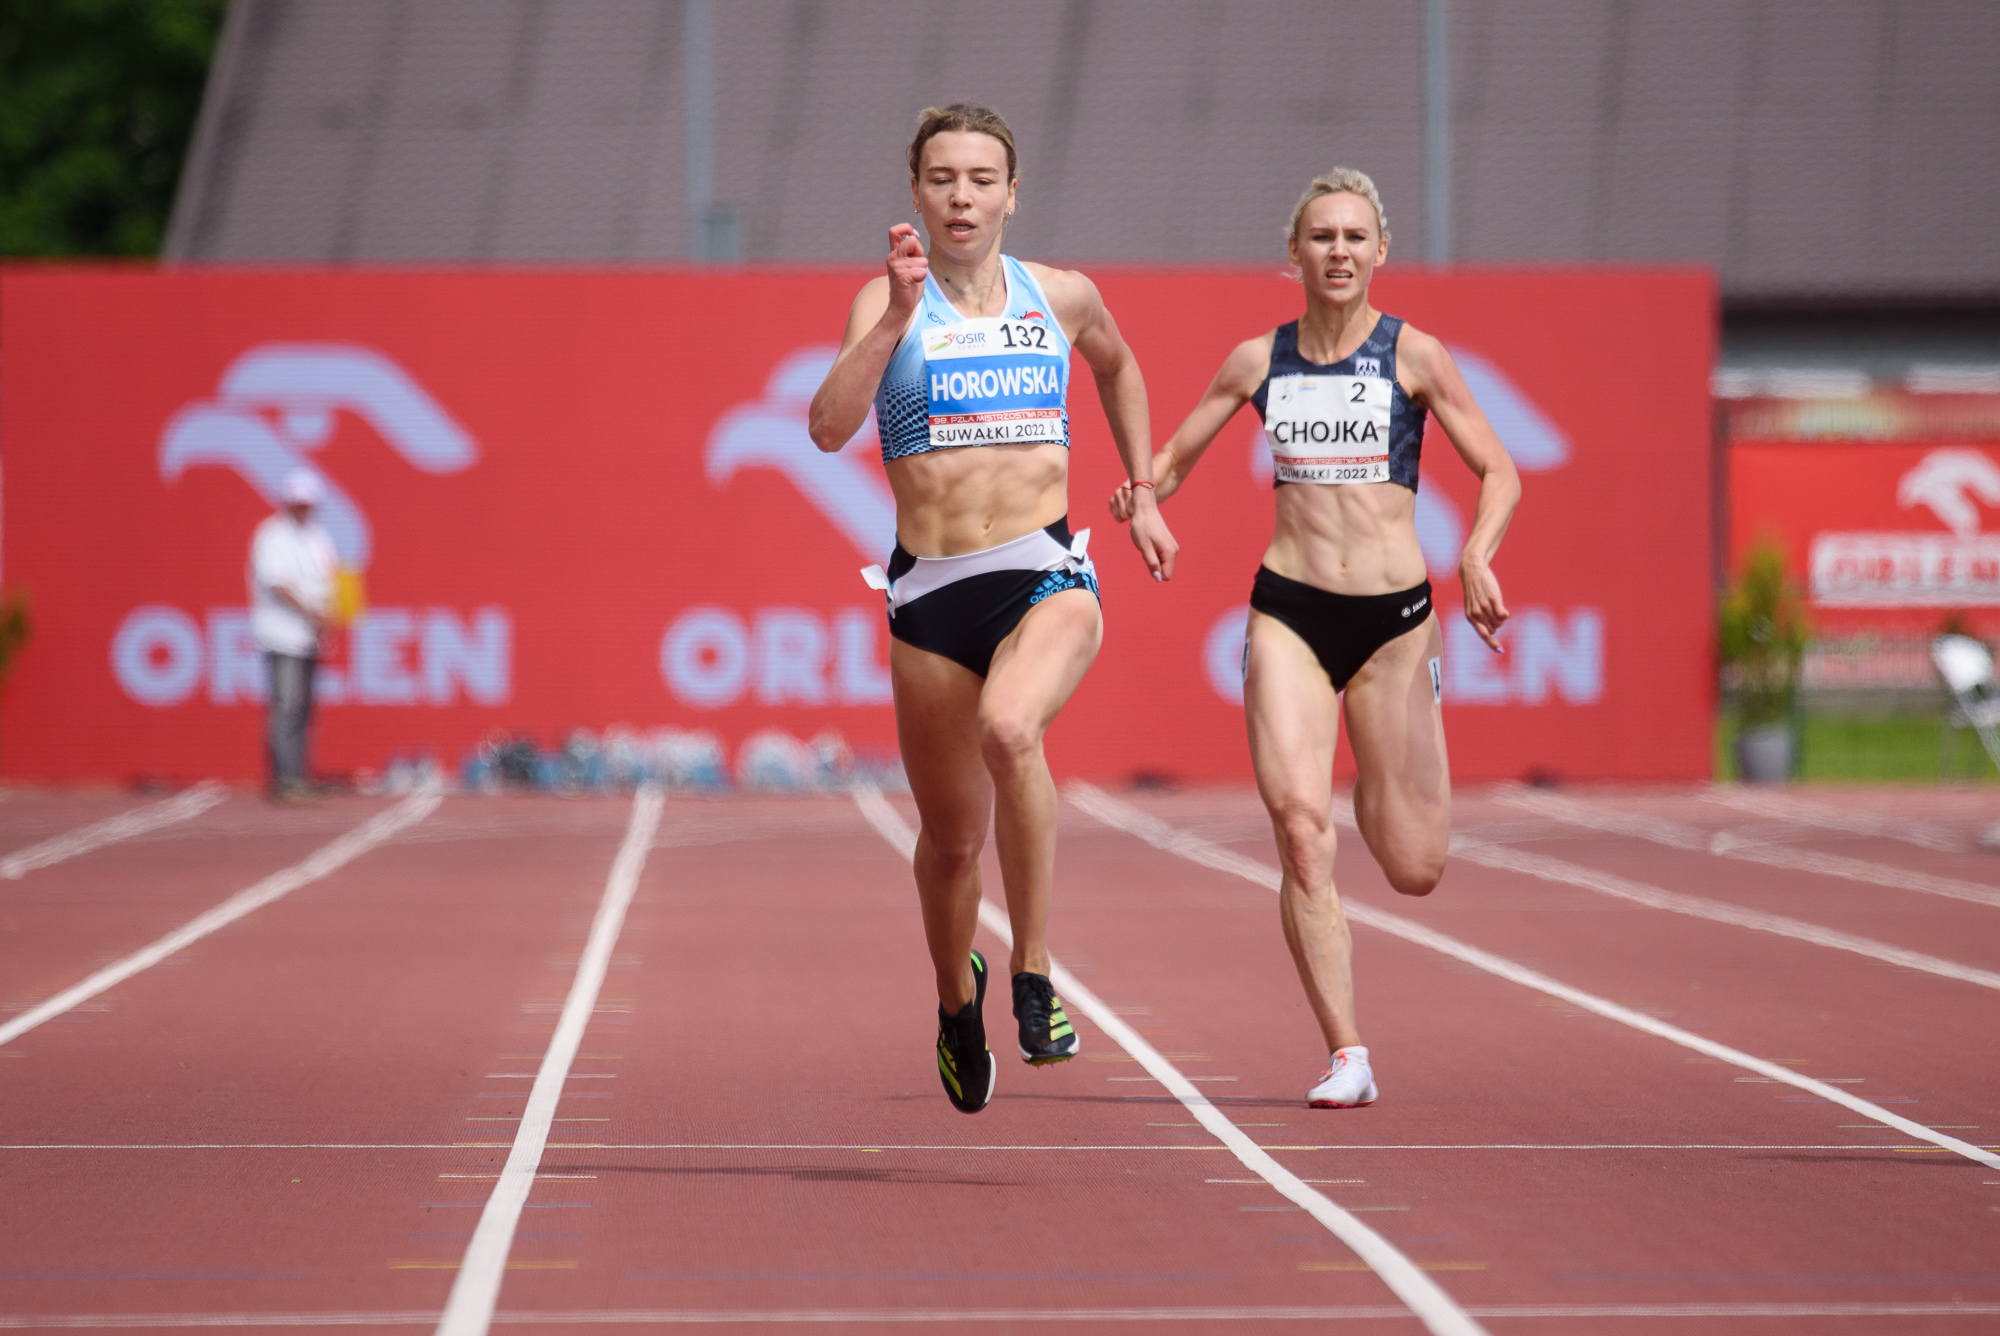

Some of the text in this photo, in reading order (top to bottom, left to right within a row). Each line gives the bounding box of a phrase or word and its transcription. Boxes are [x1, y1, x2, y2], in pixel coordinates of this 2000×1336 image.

[956, 332, 986, 345] OSIR
[999, 323, 1049, 350] 132
[932, 366, 1059, 401] HOROWSKA
[1350, 381, 1366, 403] 2
[950, 415, 974, 424] PZLA
[976, 411, 1036, 422] MISTRZOSTWA
[1037, 410, 1058, 418] POLSKI
[937, 424, 1046, 442] SUWAŁKI 2022
[1274, 421, 1378, 444] CHOJKA
[1335, 468, 1368, 480] 2022
[1029, 578, 1075, 604] adidas
[658, 606, 894, 707] ORL
